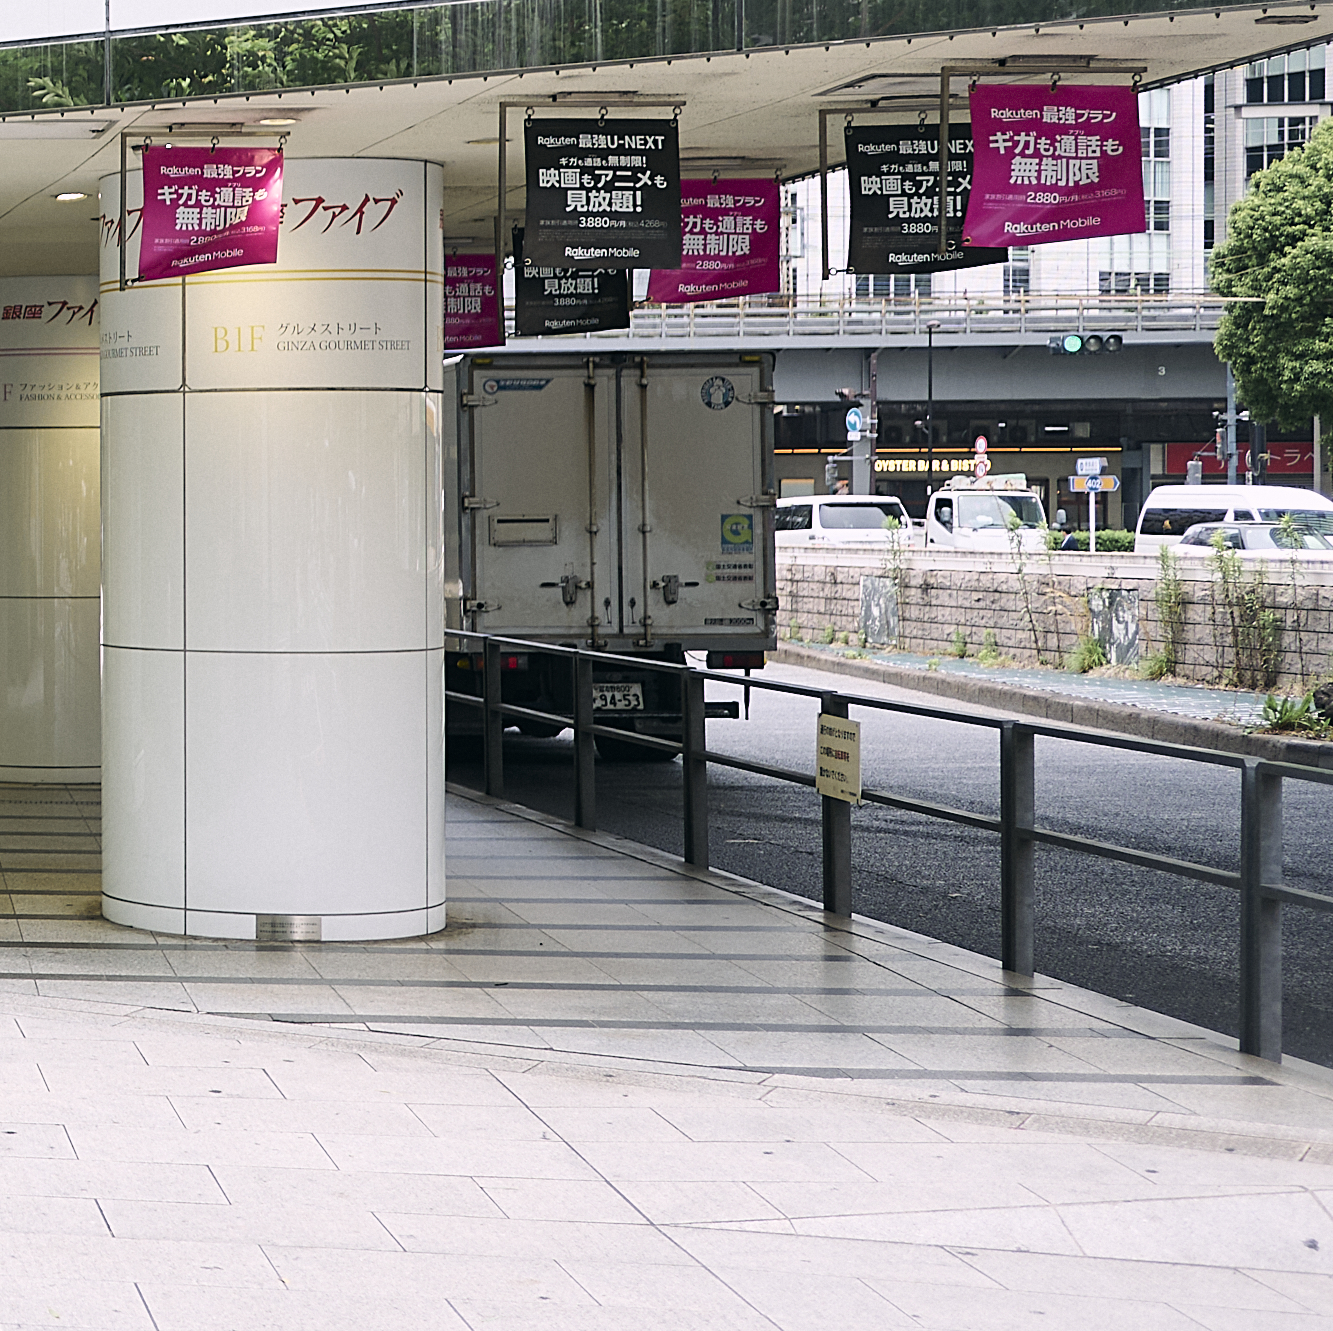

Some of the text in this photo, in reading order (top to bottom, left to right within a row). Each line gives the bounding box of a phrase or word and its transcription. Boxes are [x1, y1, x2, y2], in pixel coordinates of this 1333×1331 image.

[991, 106, 1116, 124] Rakuten 最強プラン
[538, 134, 664, 149] Rakuten 最強U-NEXT
[858, 140, 974, 154] Rakuten 最強UNEX
[989, 131, 1123, 157] ギガも通話も
[161, 164, 266, 179] Rakuten 最強プラン
[880, 160, 967, 173] ギガも通話も無限!
[1010, 156, 1099, 186] 無制限
[539, 168, 667, 188] 映画もアニメも
[861, 175, 971, 195] 映画もアニメ
[157, 185, 268, 206] ギガも通話も
[566, 190, 642, 213] 見放題!
[707, 195, 764, 208] 最強プラン
[175, 206, 249, 231] 無制限
[681, 215, 768, 233] ガも通話も
[1005, 216, 1101, 236] Rakuten Mobile
[682, 234, 750, 256] 無制限
[171, 249, 243, 267] Rakuten Mobile
[565, 247, 640, 259] Rakuten Mobile
[889, 251, 964, 265] Rakuten Mobile
[543, 278, 598, 295] 見放題!
[678, 280, 748, 295] Rakuten Mobile
[1, 298, 99, 326] 銀座ファイ
[445, 298, 481, 314] 制限
[277, 323, 381, 336] グルメストリート
[545, 318, 599, 329] Rakuten Mobile
[213, 326, 265, 353] B1F
[276, 340, 411, 352] GINZA GOURMET STREET
[130, 346, 160, 357] STREET
[1158, 366, 1166, 376] 3
[874, 459, 916, 472] OYSTER
[941, 459, 949, 472] &
[950, 459, 992, 472] BISTO
[1086, 478, 1102, 488] 402
[599, 693, 641, 707] 94-53
